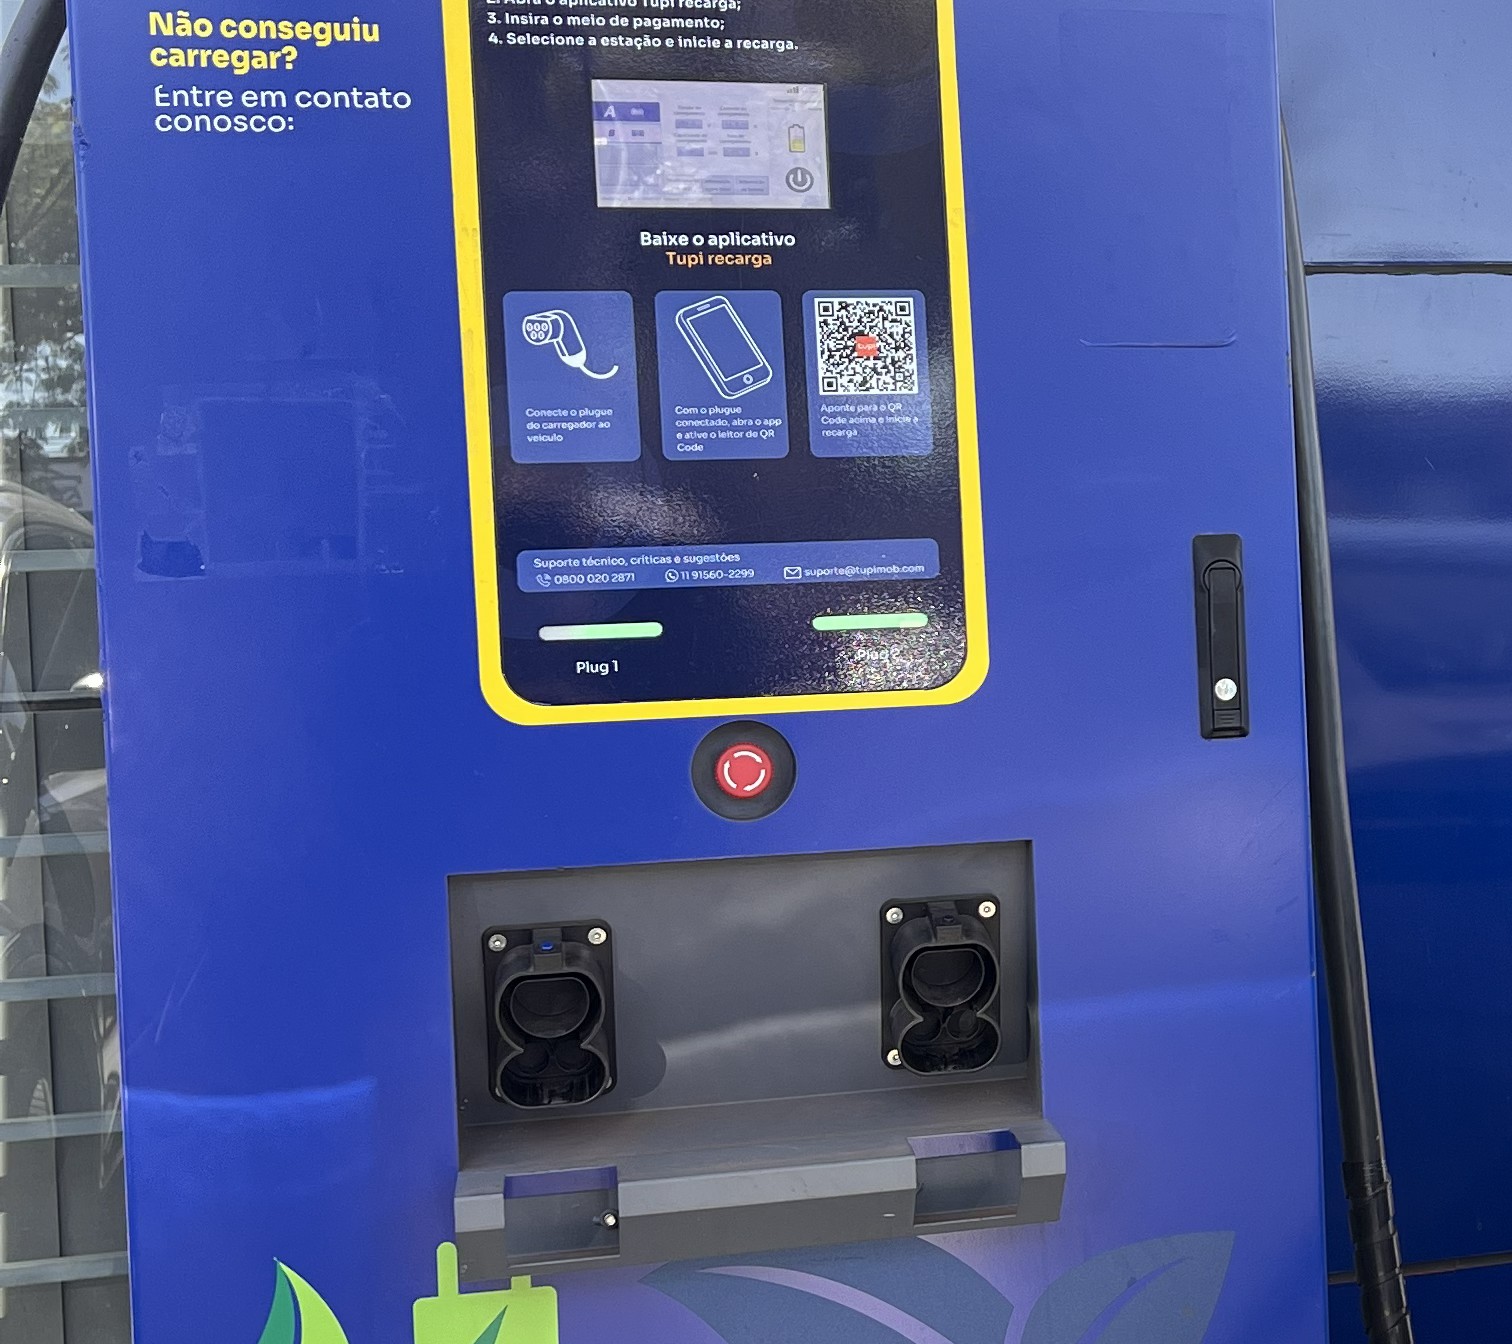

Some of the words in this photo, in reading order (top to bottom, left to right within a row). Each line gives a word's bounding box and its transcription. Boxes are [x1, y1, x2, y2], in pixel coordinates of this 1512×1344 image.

[148, 9, 213, 38] Não
[219, 16, 380, 44] conseguiu
[487, 12, 502, 24] 3.
[504, 12, 549, 25] Insira
[552, 15, 564, 26] o
[566, 13, 606, 26] meio
[609, 14, 629, 27] de
[632, 15, 725, 31] pagamento;
[488, 33, 503, 45] 4.
[506, 32, 585, 46] Selecione
[588, 36, 597, 46] a
[601, 35, 662, 50] estação
[665, 38, 675, 48] e
[678, 36, 721, 49] inicie
[724, 39, 734, 50] a
[736, 38, 799, 53] recarga.
[149, 45, 298, 75] carregar?
[154, 83, 233, 108] Entre
[240, 89, 288, 109] em
[295, 86, 412, 110] contato
[154, 111, 295, 133] conosco:
[640, 231, 690, 247] Baixe
[693, 235, 705, 247] o
[707, 230, 796, 250] aplicativo
[665, 251, 704, 268] Tupi
[707, 253, 772, 268] recarga
[525, 408, 569, 417] Conecte
[570, 409, 577, 417] o
[579, 408, 613, 418] plugue
[675, 406, 698, 415] Com
[699, 407, 707, 415] o
[709, 405, 742, 416] plugue
[820, 404, 856, 414] Aponte
[857, 404, 878, 413] para
[887, 402, 903, 412] QR
[526, 420, 540, 430] do
[541, 419, 597, 431] carregador
[598, 420, 611, 429] ao
[676, 417, 730, 428] conectado,
[732, 417, 753, 427] abra
[763, 418, 782, 428] app
[821, 416, 847, 425] Code
[849, 416, 876, 424] acima
[684, 430, 708, 439] ative
[718, 430, 744, 439] leitor
[746, 430, 758, 438] de
[759, 429, 775, 439] QR
[822, 428, 858, 439] recarga
[677, 443, 704, 452] Code
[533, 557, 580, 569] Suporte
[582, 555, 627, 567] técnico,
[630, 554, 672, 565] críticas
[674, 556, 681, 564] e
[683, 552, 740, 567] sugestões
[681, 571, 690, 581] 11
[691, 568, 755, 581] 91560-2299
[804, 563, 925, 578] suporte@tupimob.com
[554, 574, 586, 585] 0800
[587, 573, 610, 584] 020
[611, 572, 636, 583] 2871
[576, 660, 609, 676] Plug
[612, 659, 619, 672] 1
